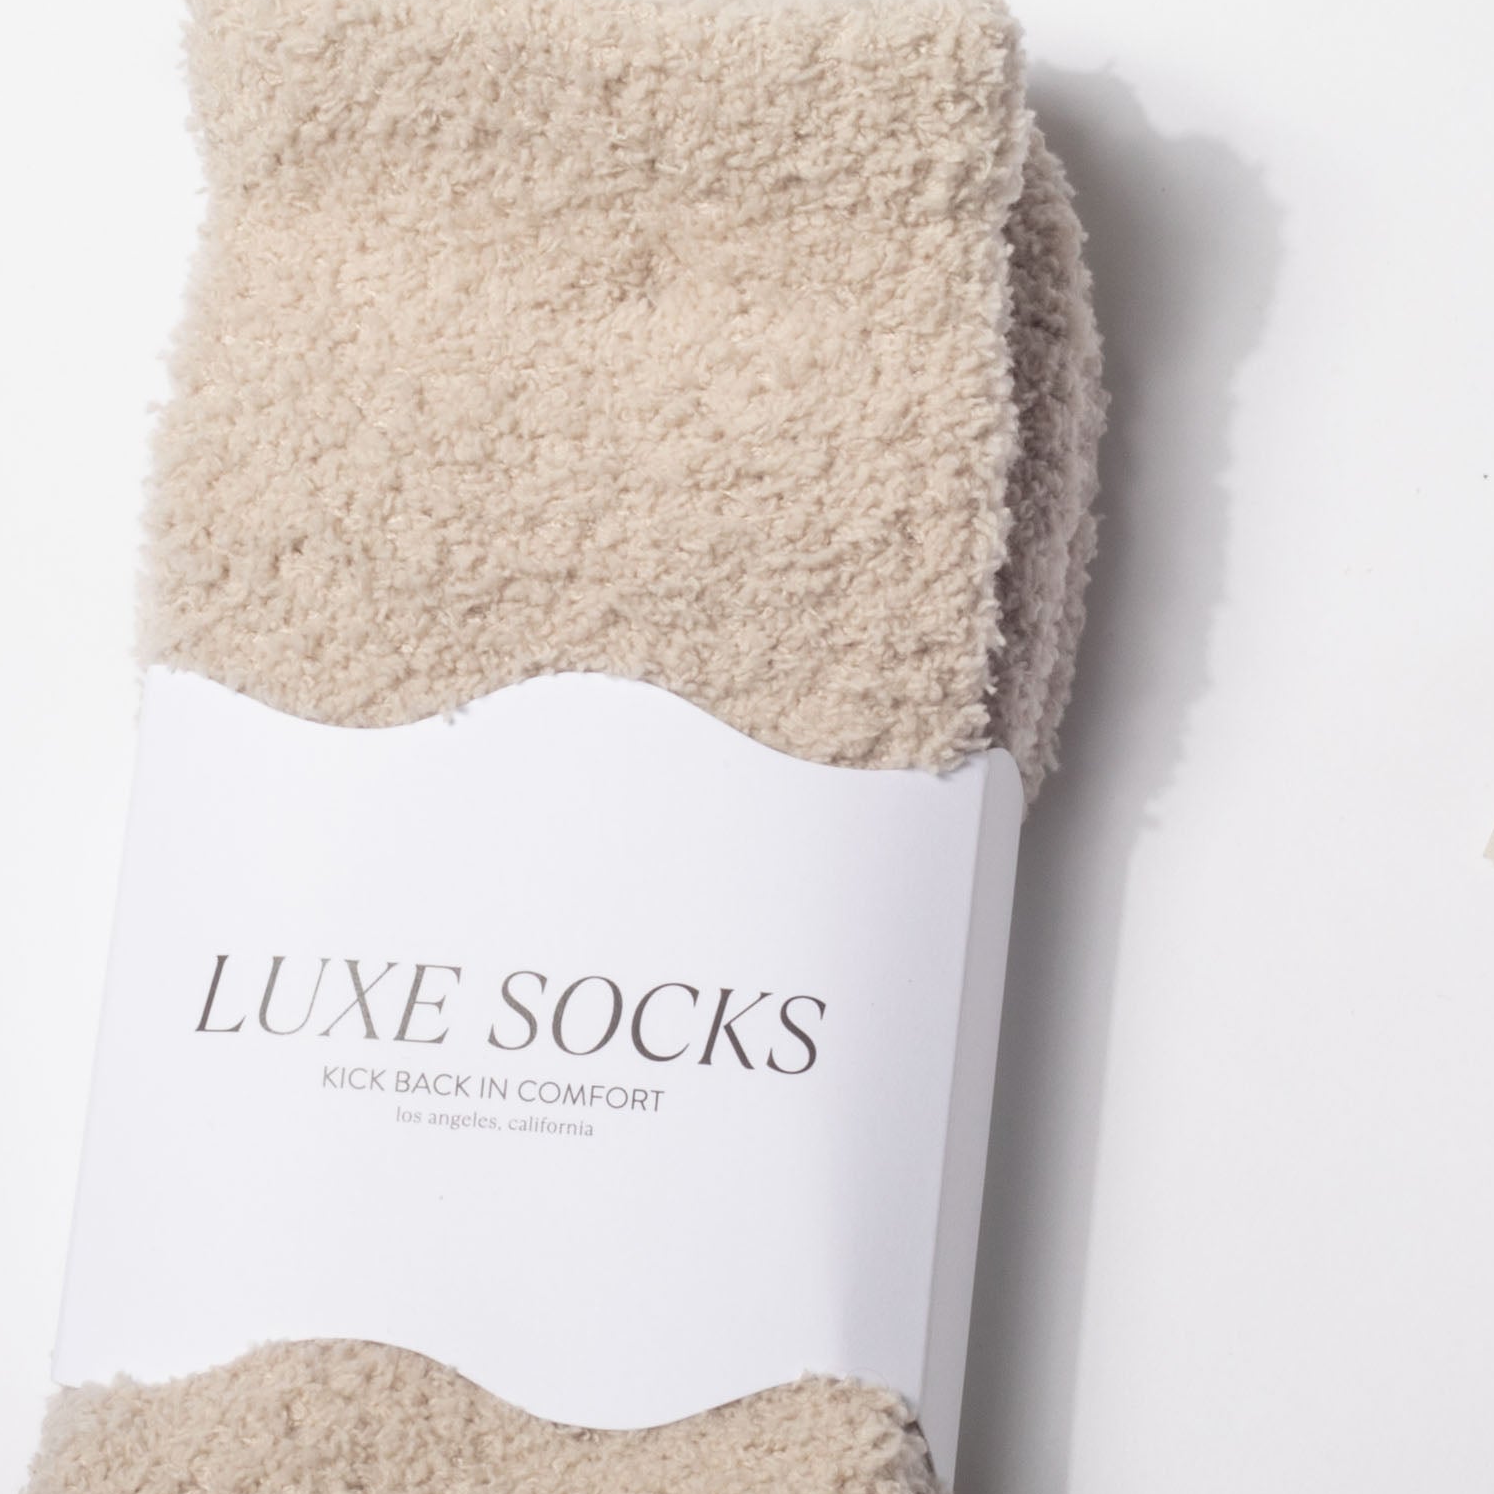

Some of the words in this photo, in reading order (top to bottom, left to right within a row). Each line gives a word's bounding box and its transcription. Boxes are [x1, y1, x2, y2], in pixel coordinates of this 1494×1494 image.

[194, 954, 462, 1045] LUXE
[487, 970, 827, 1076] SOCKS
[322, 1065, 387, 1092] KICK
[394, 1070, 472, 1098] BACK
[479, 1076, 509, 1100] IN
[517, 1079, 666, 1113] COMFORT
[395, 1105, 423, 1124] los
[427, 1110, 502, 1132] angeles,
[507, 1115, 594, 1137] california
